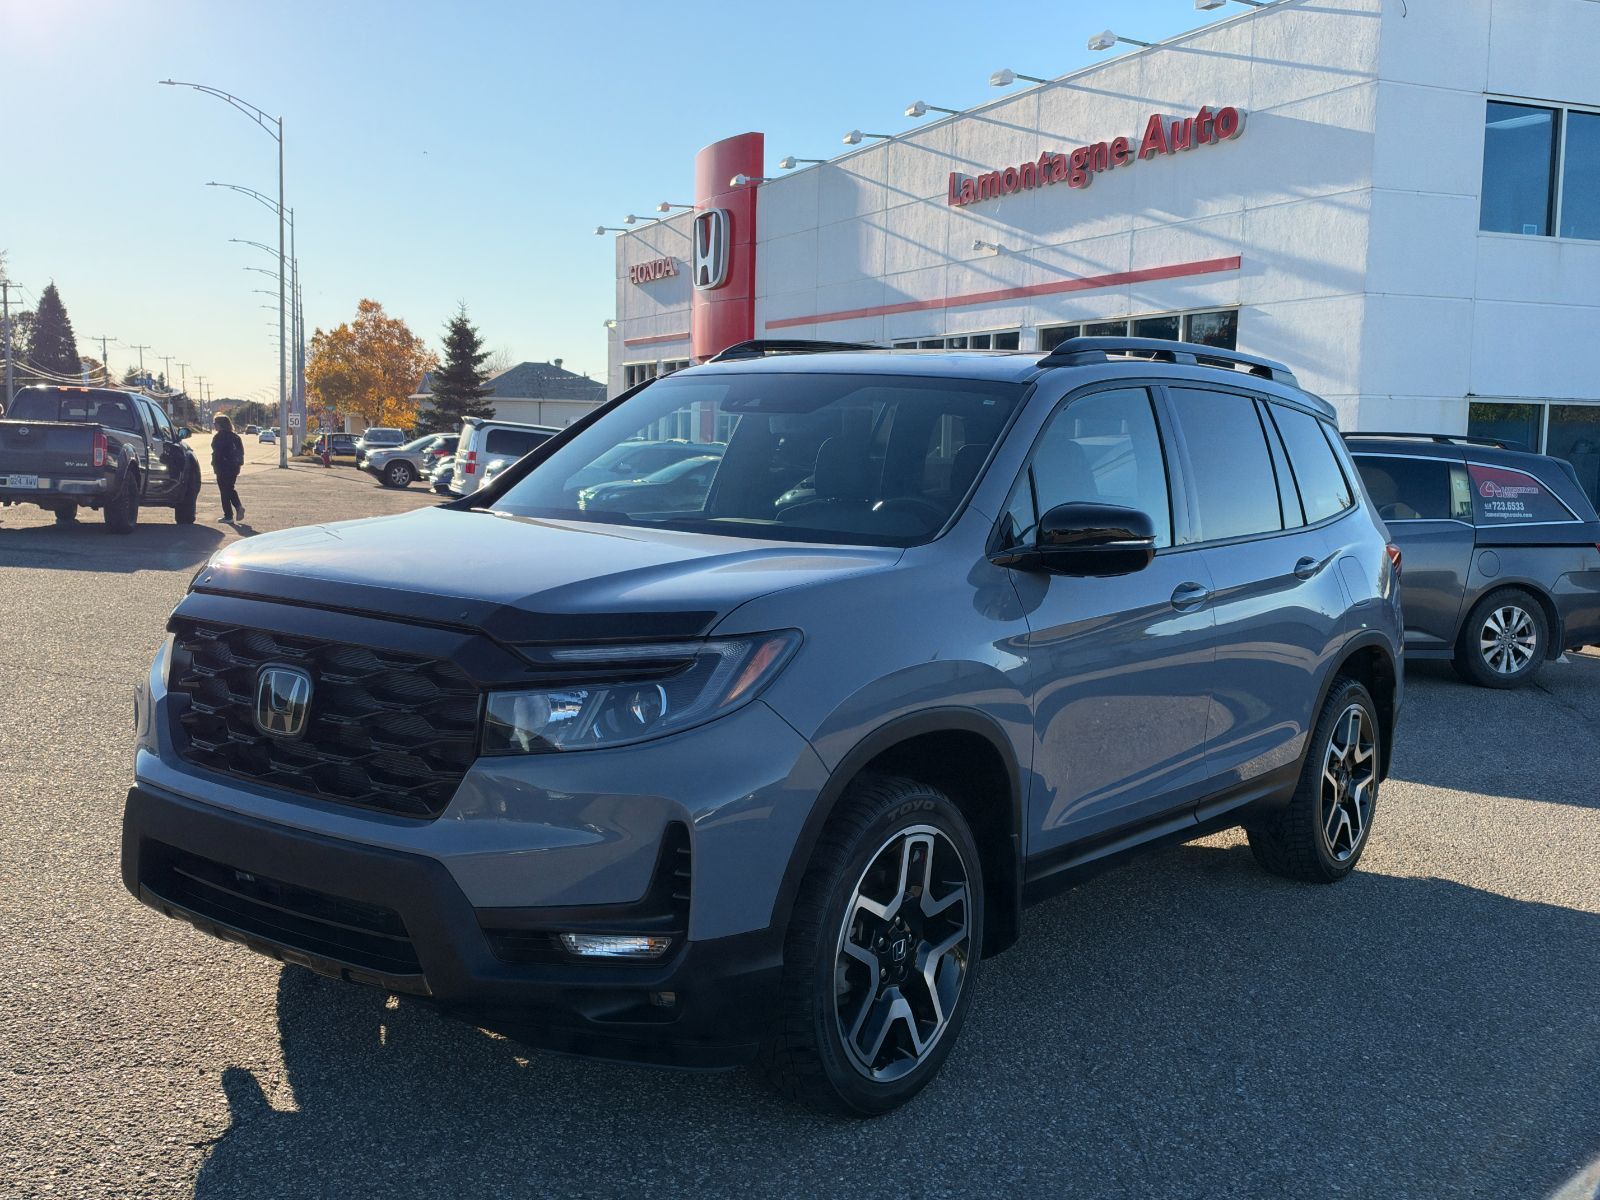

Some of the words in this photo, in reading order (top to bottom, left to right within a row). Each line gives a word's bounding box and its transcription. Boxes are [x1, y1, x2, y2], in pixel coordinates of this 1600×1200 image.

[948, 136, 1131, 206] Lamontagne
[1137, 105, 1246, 160] Auto
[629, 256, 675, 284] HONDA
[289, 417, 300, 426] 50
[1492, 501, 1525, 511] 723.6533
[887, 799, 935, 822] TOYO
